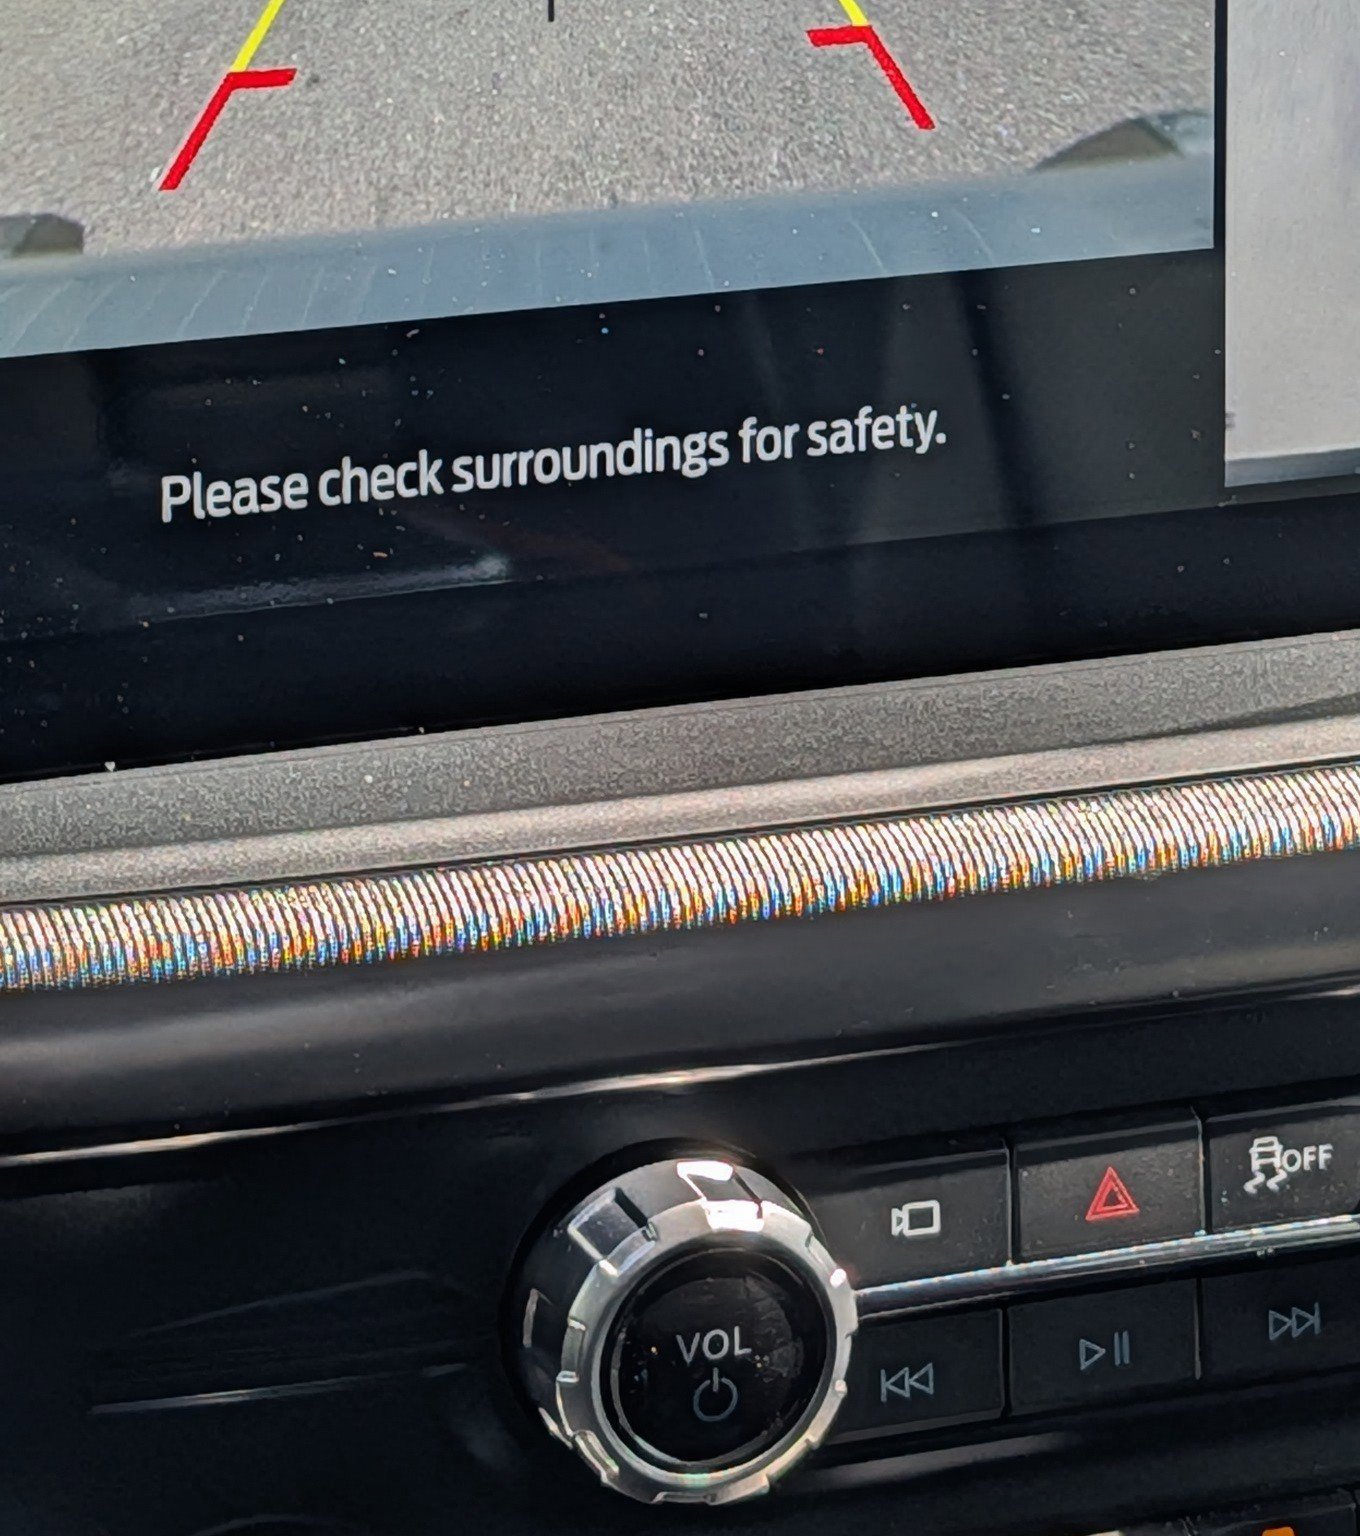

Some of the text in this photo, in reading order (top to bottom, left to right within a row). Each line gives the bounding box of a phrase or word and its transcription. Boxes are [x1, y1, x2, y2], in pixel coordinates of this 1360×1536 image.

[161, 404, 948, 524] Please check surroundings for safety.
[1280, 1143, 1334, 1173] OFF
[675, 1325, 753, 1366] VOL
